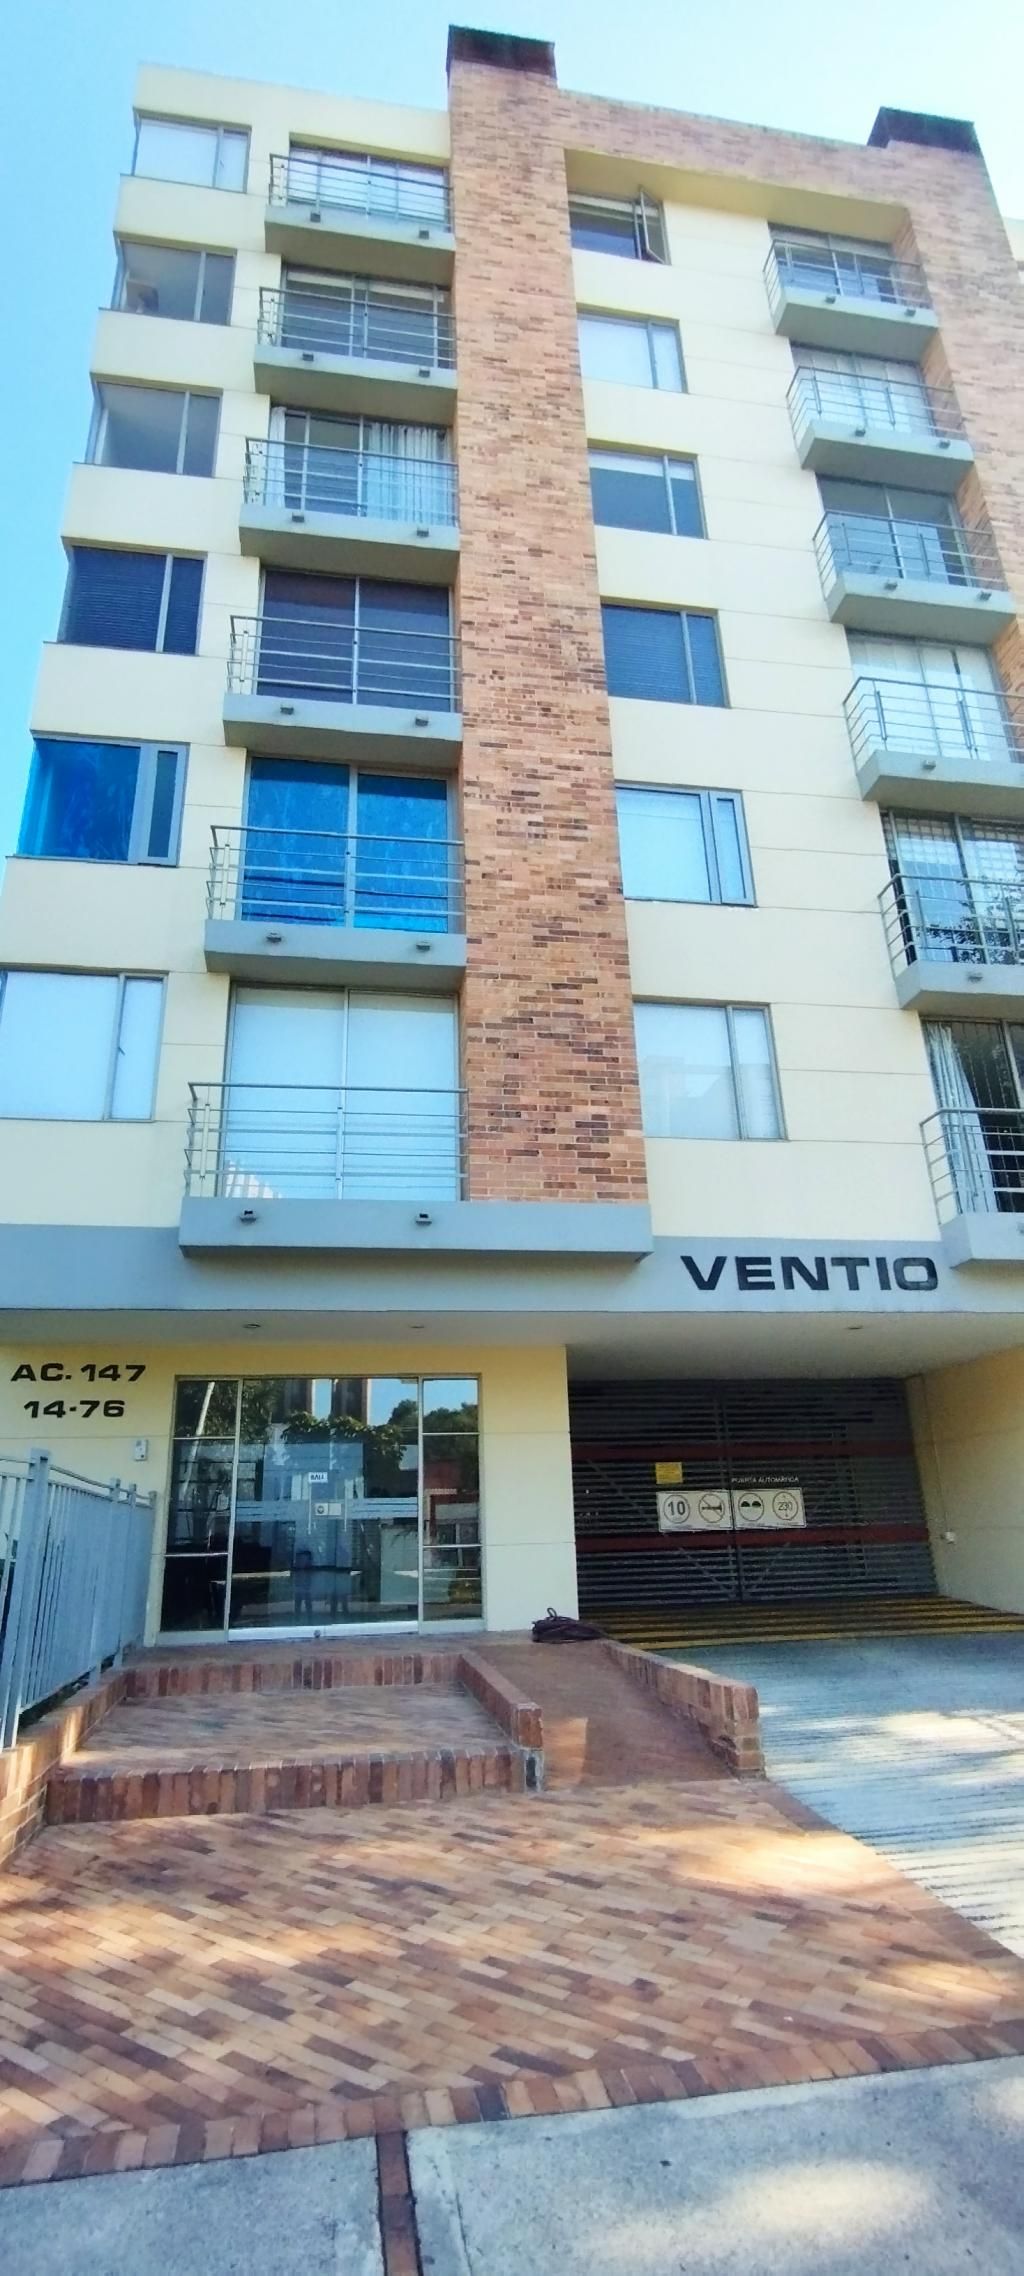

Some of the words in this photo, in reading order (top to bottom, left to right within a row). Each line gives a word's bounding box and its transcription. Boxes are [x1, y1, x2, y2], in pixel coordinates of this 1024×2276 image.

[680, 1255, 939, 1291] VENTIO
[10, 1363, 73, 1382] AC.
[80, 1364, 147, 1382] 147
[23, 1400, 126, 1418] 14-76
[667, 1501, 686, 1516] 10
